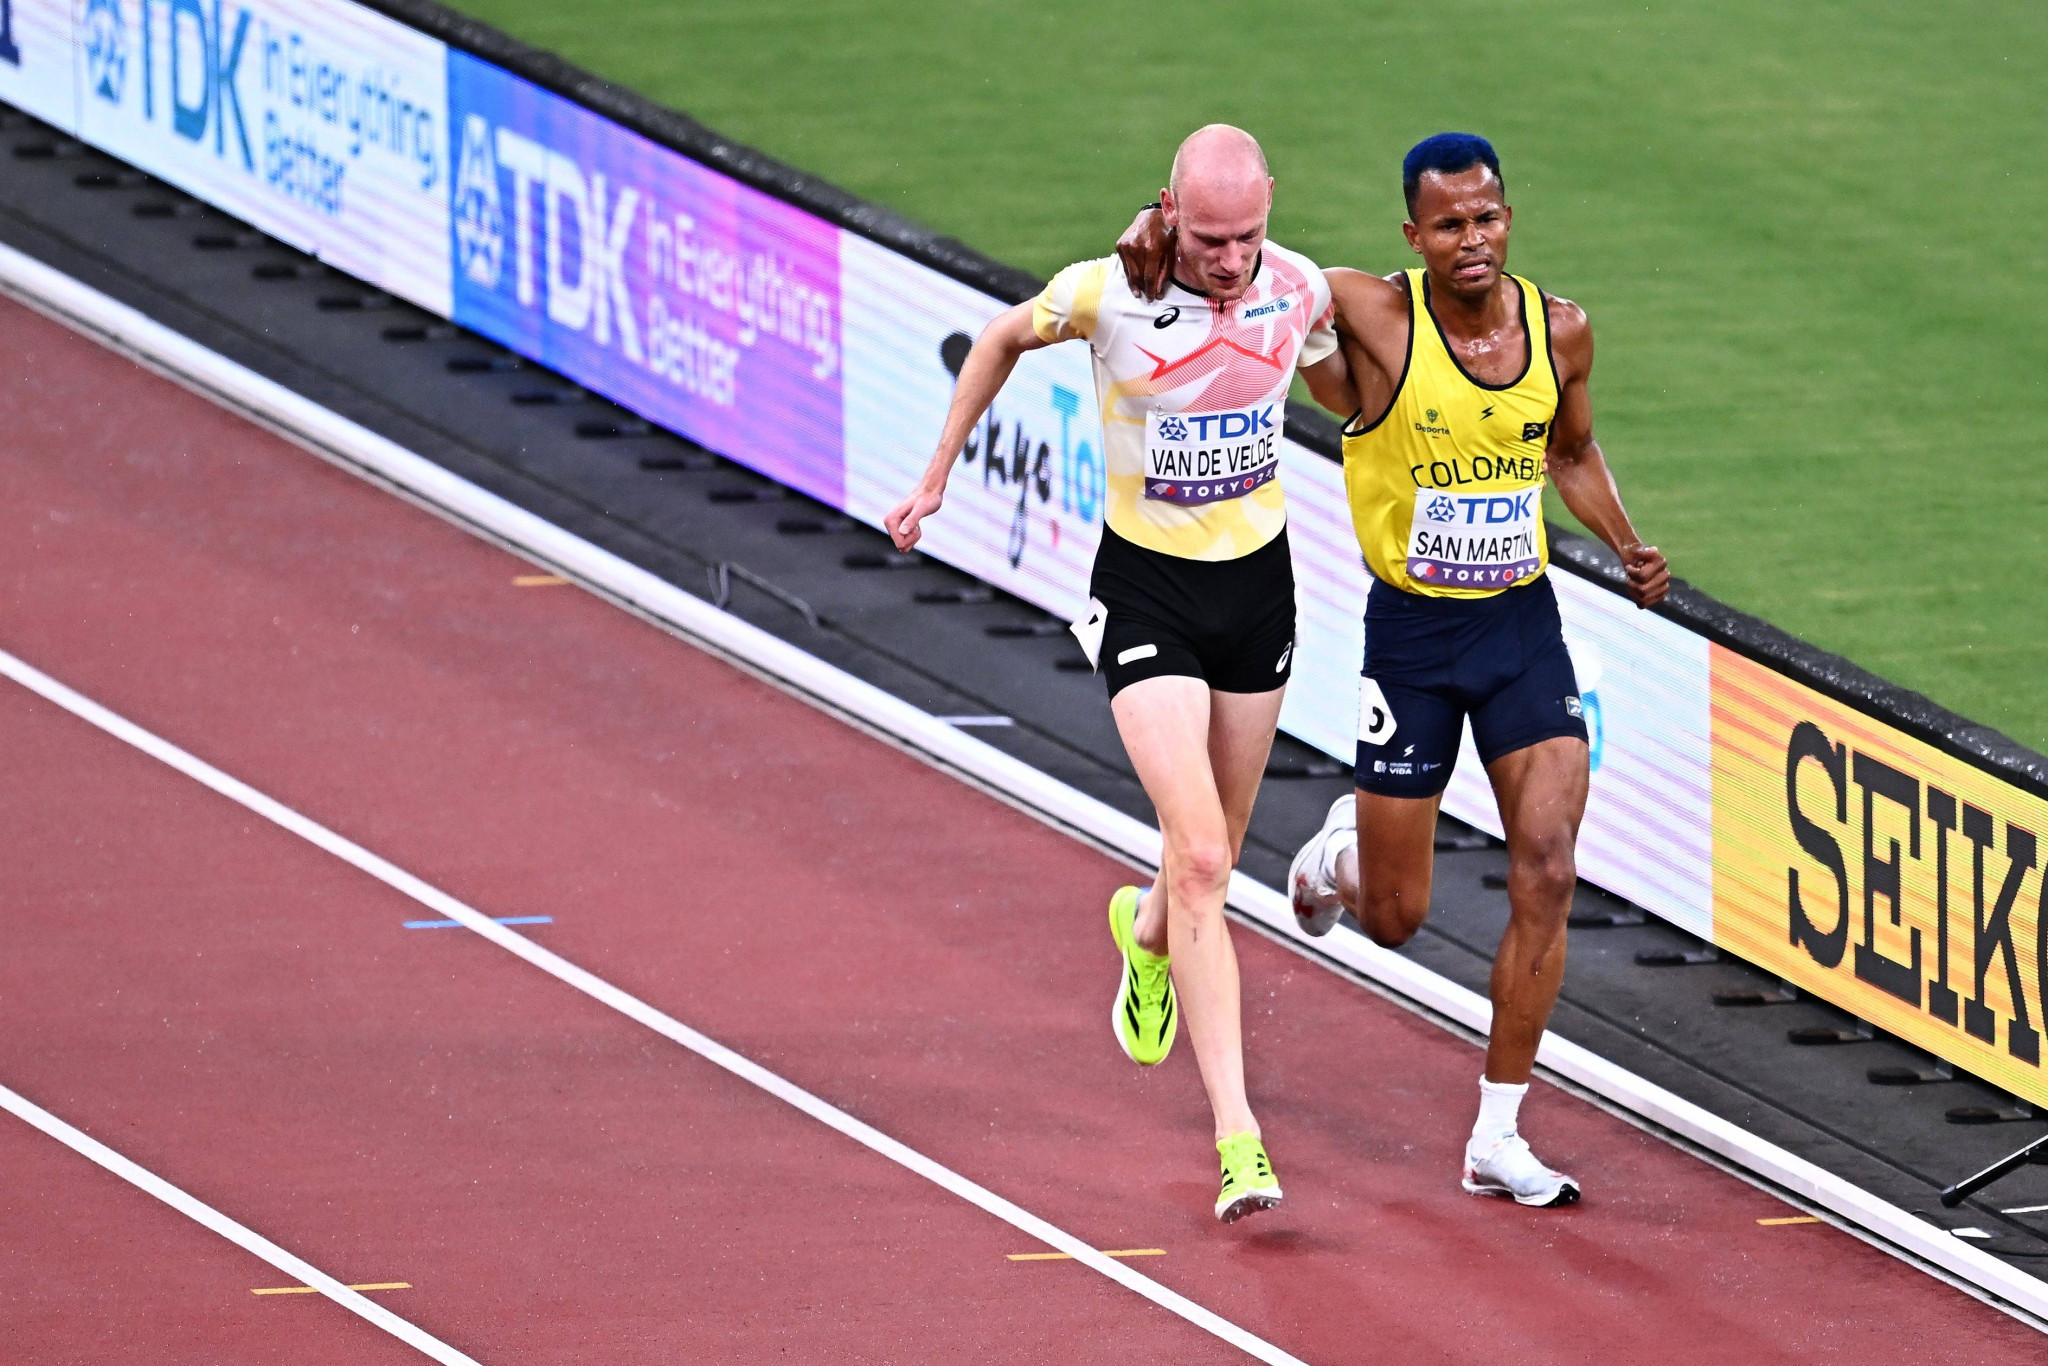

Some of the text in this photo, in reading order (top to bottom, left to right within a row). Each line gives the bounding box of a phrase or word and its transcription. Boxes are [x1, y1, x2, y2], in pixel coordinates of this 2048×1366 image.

[263, 108, 345, 213] Better
[288, 32, 438, 188] Everything
[495, 126, 645, 363] TDK
[674, 212, 838, 384] Everything
[648, 296, 739, 409] Better
[1152, 432, 1275, 477] VAN DE VELDE
[1188, 403, 1275, 442] TDK
[1411, 456, 1545, 489] COLOMBI
[1415, 526, 1533, 562] SAN MARTÍN
[1457, 491, 1533, 524] TDK
[1786, 720, 2048, 1070] SEIK
